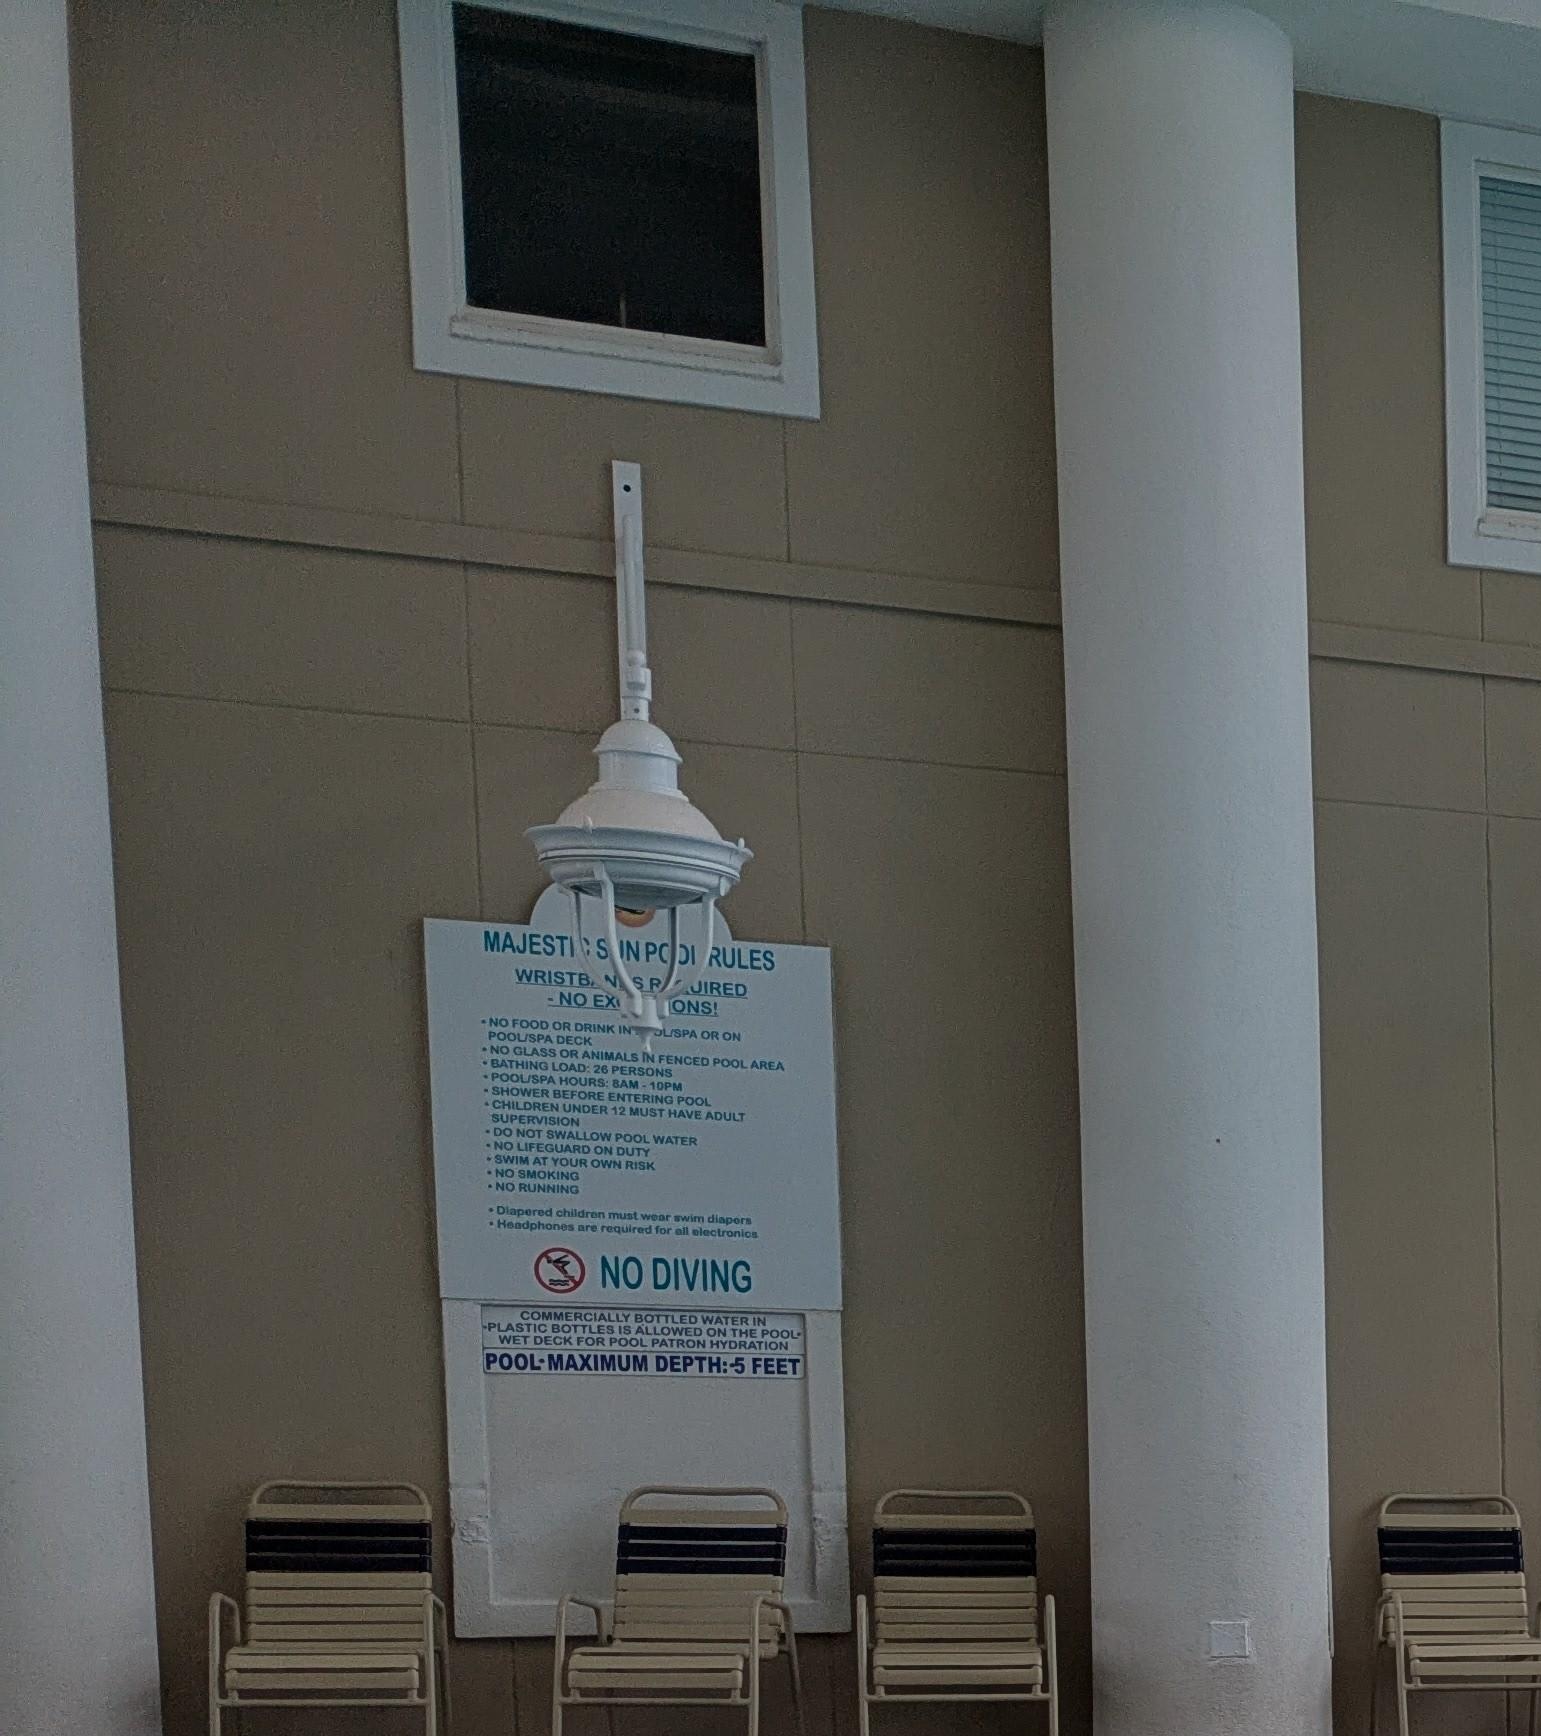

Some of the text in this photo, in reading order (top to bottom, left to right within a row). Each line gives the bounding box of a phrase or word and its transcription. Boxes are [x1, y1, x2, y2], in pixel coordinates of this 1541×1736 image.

[709, 947, 775, 971] RULES
[515, 968, 747, 997] WRISTBNS RUIRED
[559, 992, 587, 1006] NO
[593, 994, 717, 1016] EXONS!
[488, 1032, 592, 1046] POOL/SPA DECK
[489, 1018, 508, 1027] NO
[512, 1019, 549, 1030] FOOD
[552, 1021, 571, 1031] OR
[575, 1023, 615, 1034] DRINK
[619, 1025, 631, 1035] IN
[701, 1030, 719, 1040] OR
[723, 1032, 741, 1042] ON
[490, 1046, 785, 1071] NO GLASS OR ANIMALS IN FENCED POOL AREA
[491, 1060, 548, 1071] BATHING
[593, 1065, 608, 1074] 26
[612, 1065, 673, 1078] PERSONS
[491, 1073, 556, 1085] POOL/SPA
[560, 1076, 608, 1088] HOURS:
[651, 1081, 682, 1092] 10PM
[491, 1087, 712, 1107] SHOWER BEFORE ENTERING POOL
[491, 1114, 580, 1127] SUPERVISION
[492, 1100, 746, 1122] CHILDREN UNDER 12 MUST HAVE ADULT
[493, 1128, 698, 1146] DO NOT SWALLOW POOL WATER
[494, 1142, 650, 1157] NO LIFEGUARD ON DUTY
[494, 1155, 656, 1171] SWIM AT YOUR OWN RISK
[495, 1169, 579, 1181] NO SMOKING
[495, 1182, 579, 1194] NO RUNNING
[496, 1206, 752, 1225] Diapered children must wear swim diapers
[497, 1220, 758, 1239] Headphones are required for all electronics
[600, 1255, 752, 1293] NO DIVING
[520, 1311, 766, 1327] COMMERCIALLY BOTTLED WATER IN
[552, 1324, 614, 1335] BOTTLES
[619, 1325, 631, 1335] IS
[635, 1325, 702, 1337] ALLOWED
[706, 1327, 727, 1338] ON
[731, 1328, 757, 1338] THE
[498, 1335, 788, 1351] WET DECK FOR POOL PATRON HYDRATION
[548, 1353, 648, 1372] MAXIMUM
[655, 1355, 727, 1374] DEPTH:
[752, 1358, 800, 1375] FEET
